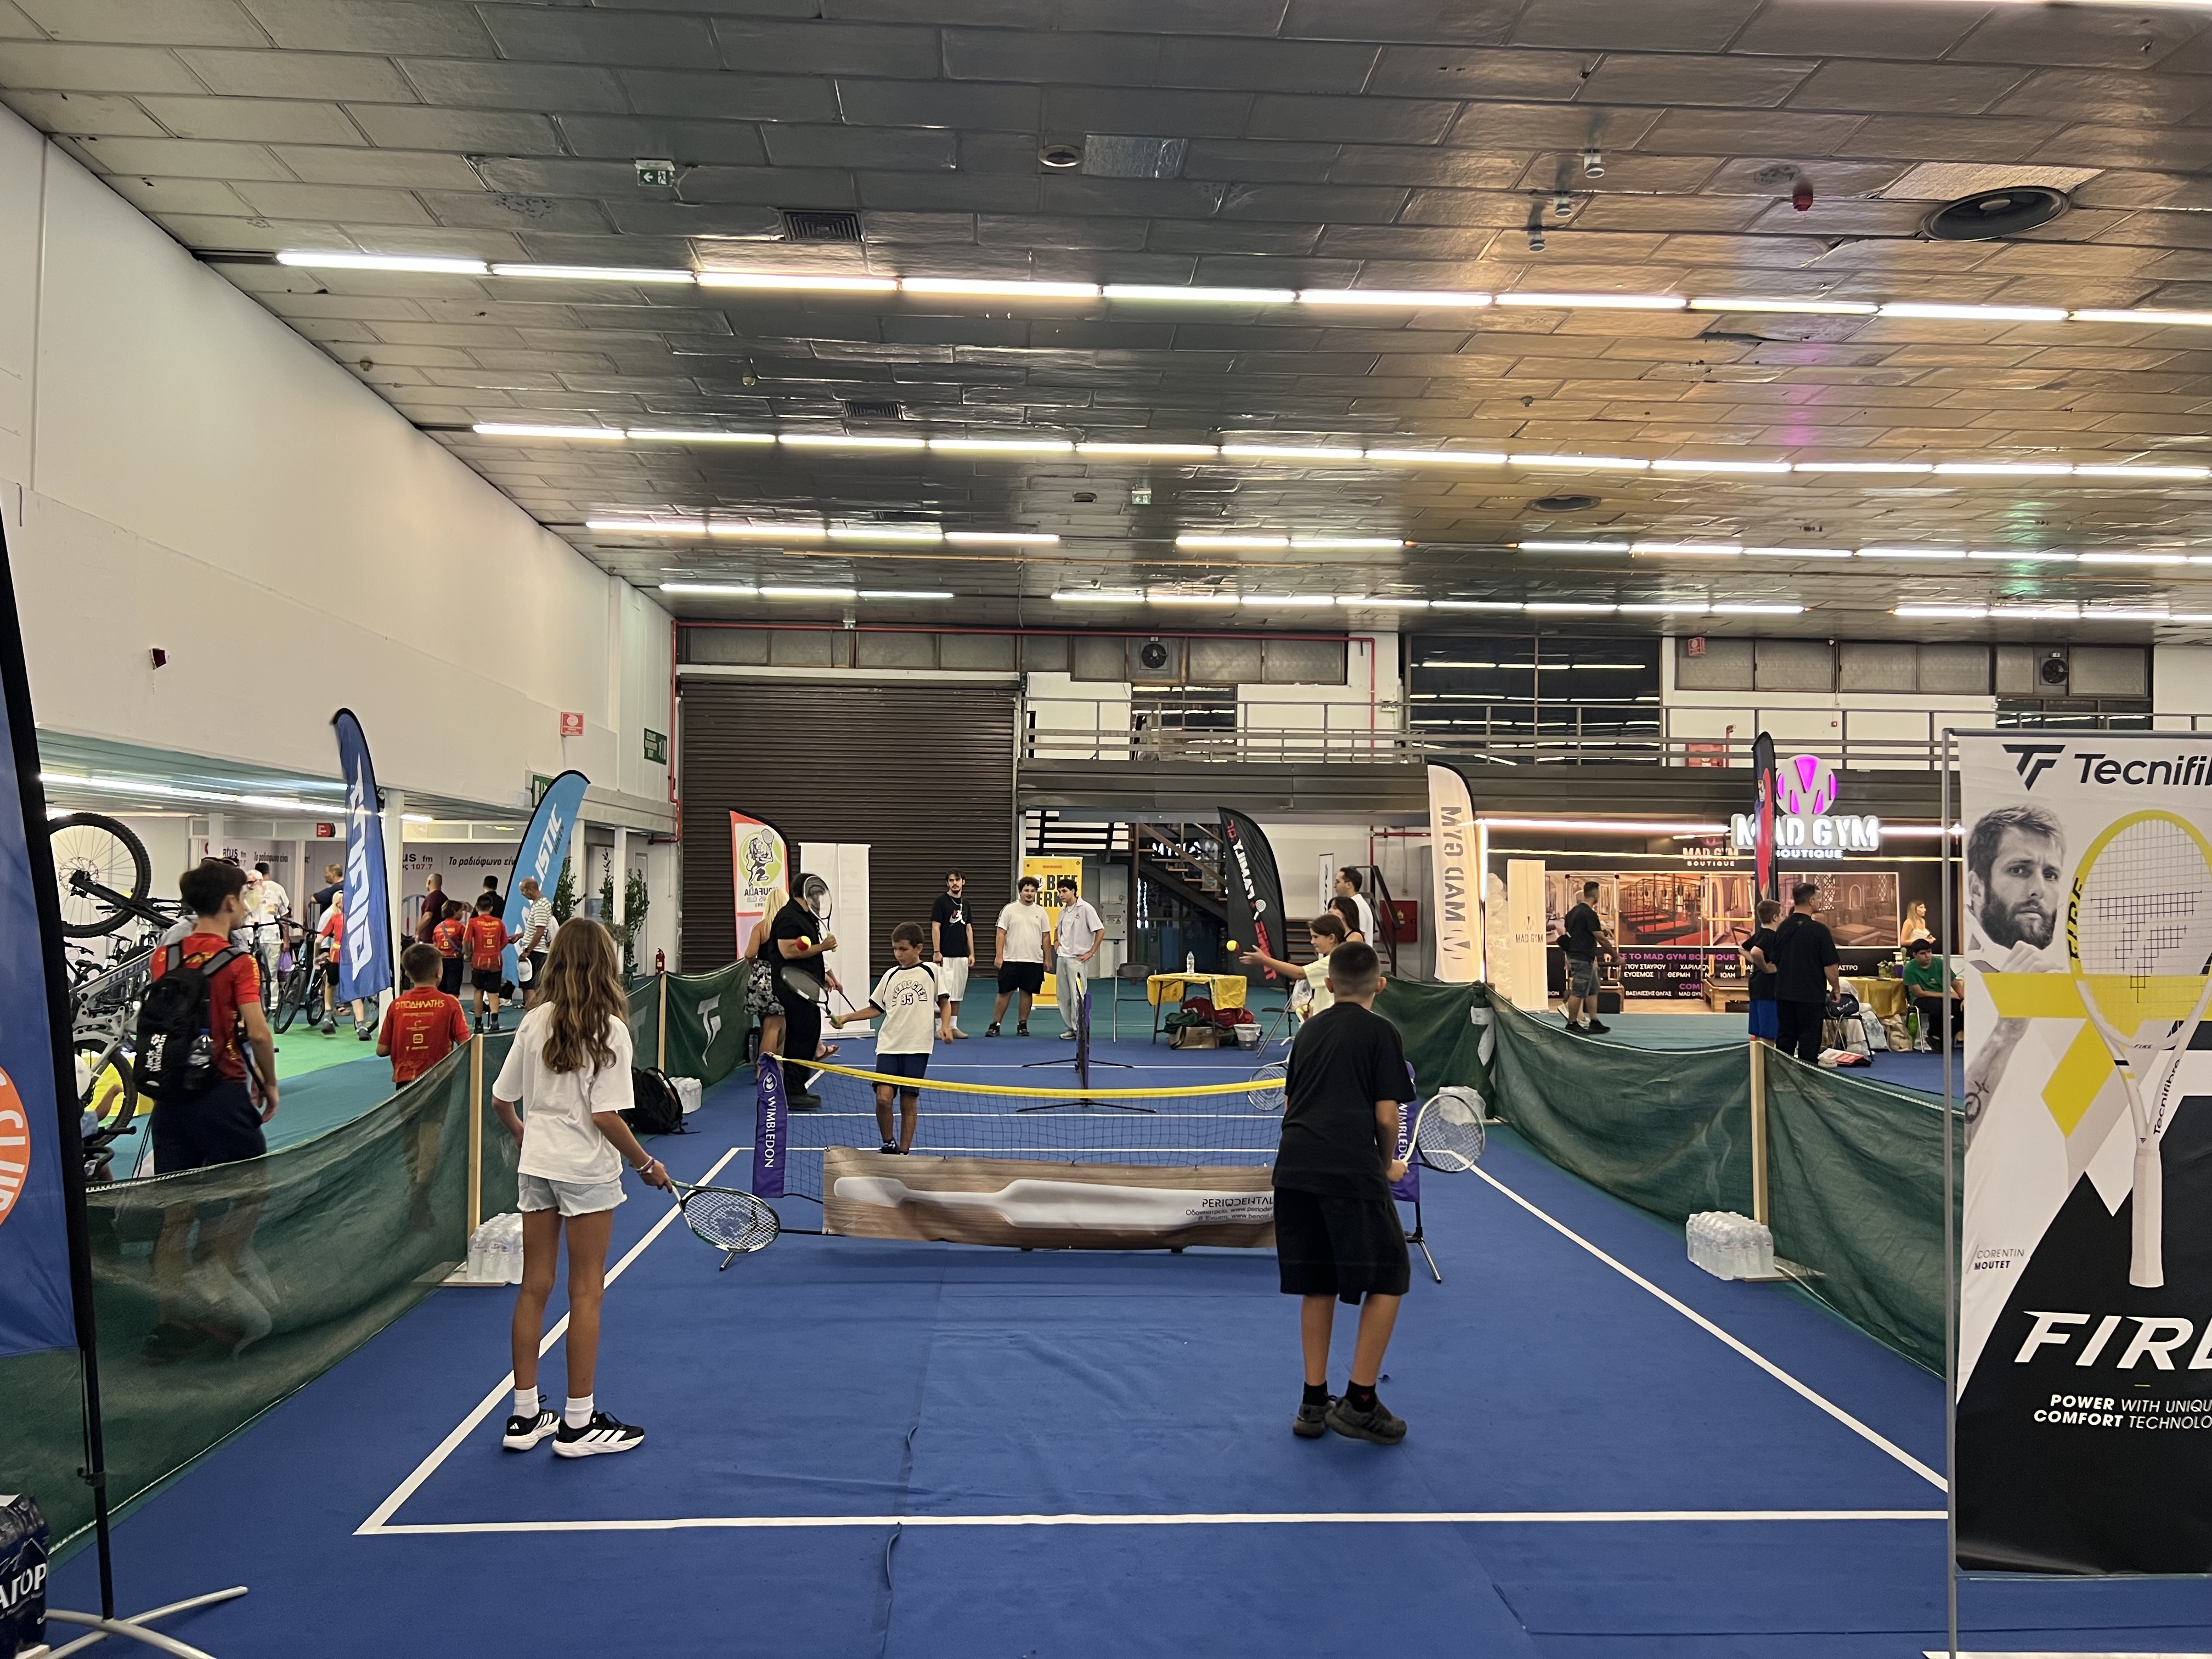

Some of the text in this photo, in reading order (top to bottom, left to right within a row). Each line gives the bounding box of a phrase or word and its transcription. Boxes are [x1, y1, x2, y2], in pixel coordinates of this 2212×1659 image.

[2074, 753, 2212, 786] Tecnifi
[1813, 819, 1878, 847] GYM
[223, 847, 238, 858] atus
[449, 856, 515, 867] Το ραδιόφωνο είν
[1036, 891, 1063, 907] ERK
[1515, 934, 1543, 943] MAD GYM
[2153, 1059, 2181, 1135] Tecnifibre
[764, 1096, 776, 1167] WIMBLEDON
[1398, 1103, 1408, 1160] WIMBLEDO
[1977, 1249, 2024, 1259] CORENTIN
[1974, 1260, 2010, 1270] MOUTET
[2050, 1394, 2212, 1414] POWER WITH UNIQU
[2034, 1410, 2124, 1427] COMFORT
